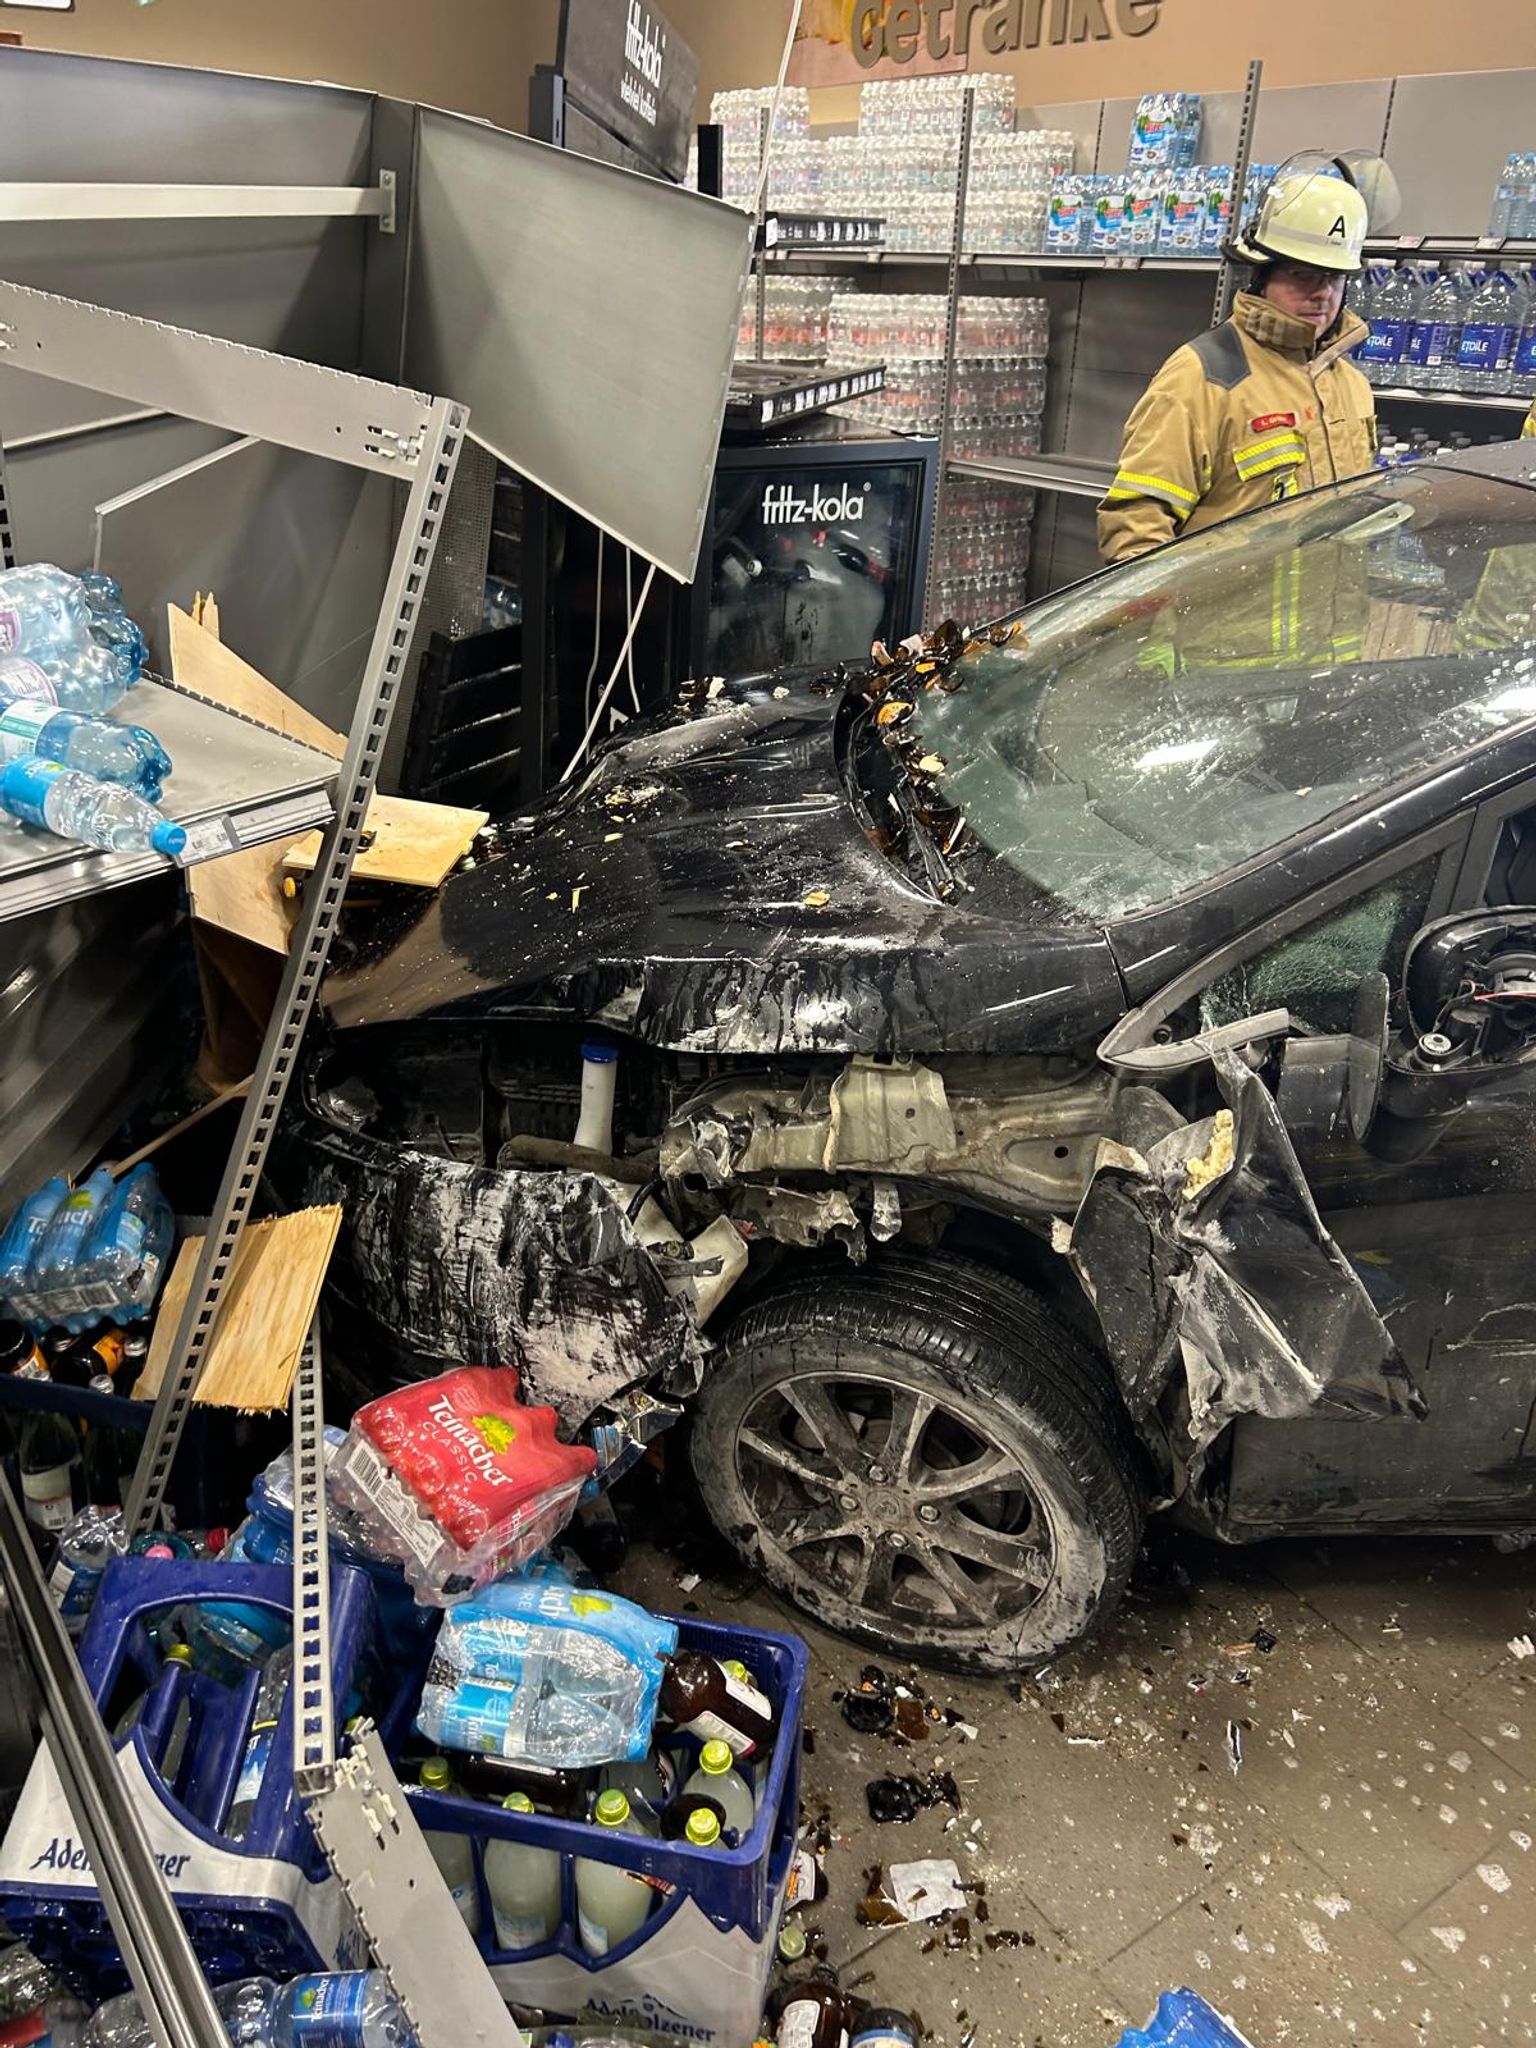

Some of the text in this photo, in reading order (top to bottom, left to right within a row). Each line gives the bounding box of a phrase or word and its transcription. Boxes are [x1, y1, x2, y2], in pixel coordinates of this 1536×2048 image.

[1327, 215, 1346, 239] A
[422, 1420, 478, 1484] CLASSIC
[428, 1393, 513, 1487] Teinacher
